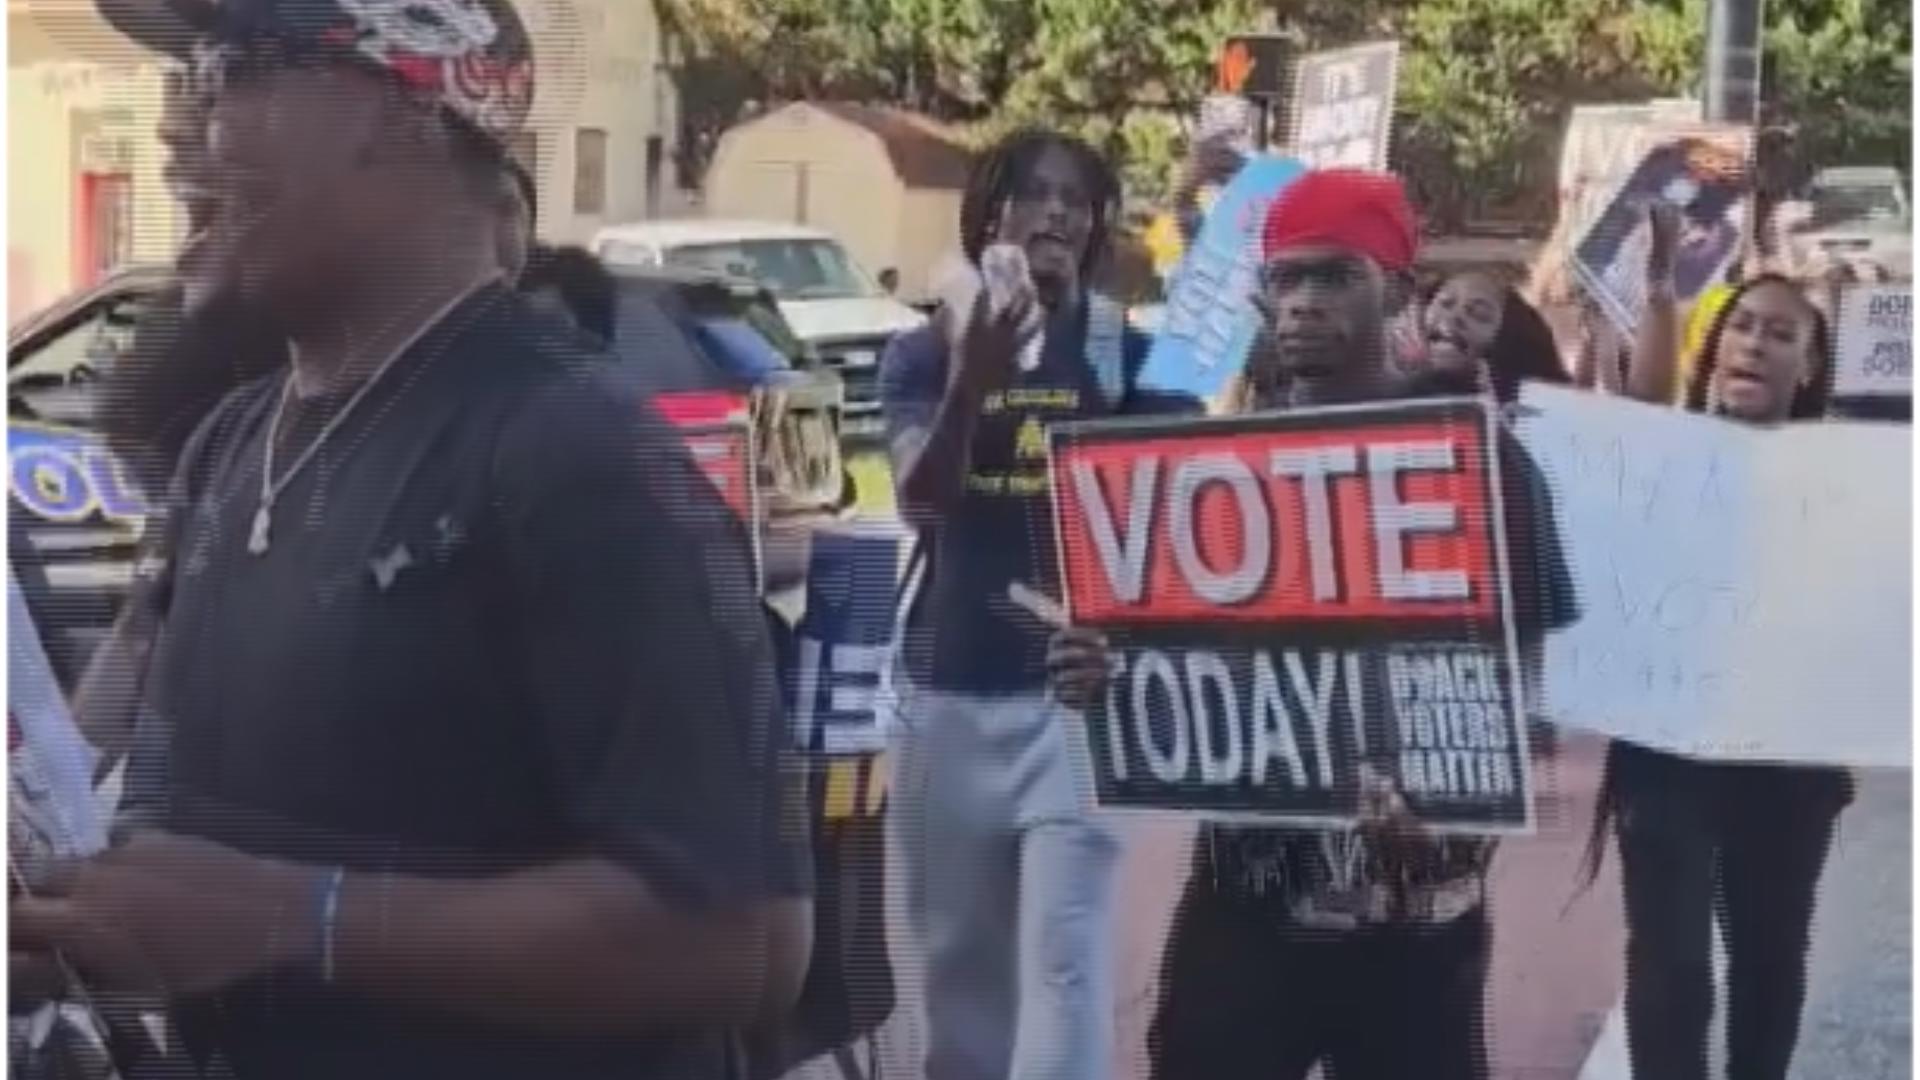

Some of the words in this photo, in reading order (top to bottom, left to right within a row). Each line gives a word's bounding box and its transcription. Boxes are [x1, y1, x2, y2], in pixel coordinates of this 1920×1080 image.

[1070, 440, 1471, 605] VOTE
[1104, 645, 1366, 790] TODAY!
[1396, 701, 1508, 749] VOTERS
[1401, 749, 1514, 797] MATTER
